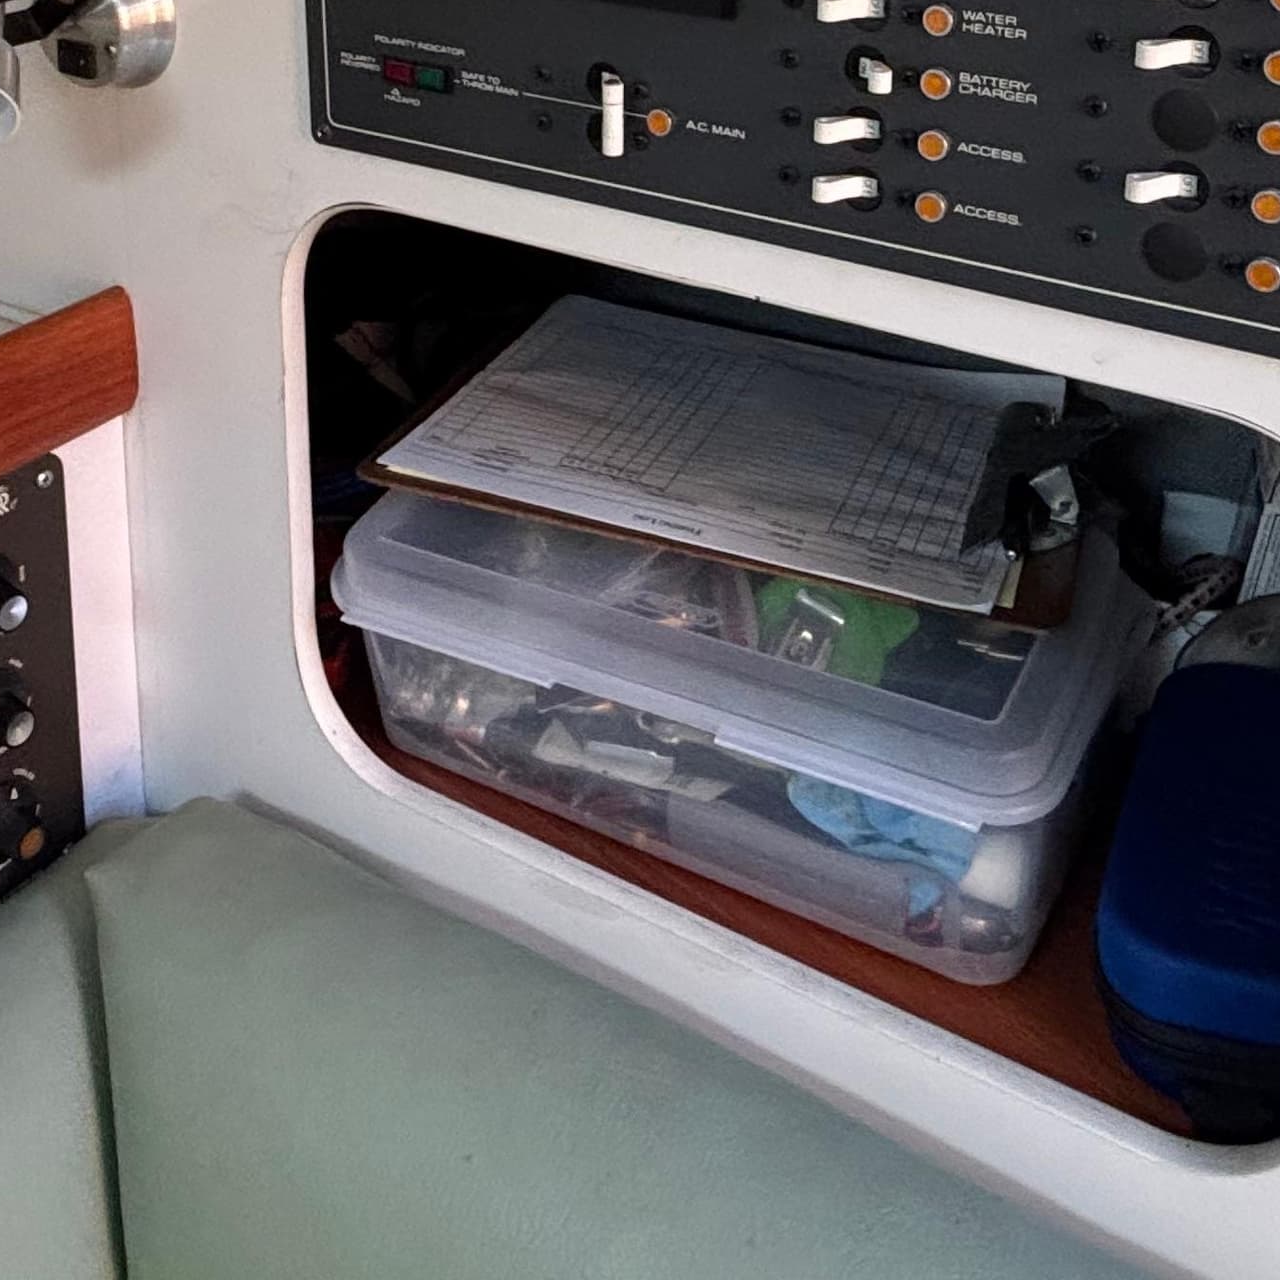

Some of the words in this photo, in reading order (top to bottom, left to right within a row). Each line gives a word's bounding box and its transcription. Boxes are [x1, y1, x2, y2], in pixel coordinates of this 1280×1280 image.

[963, 10, 1017, 26] WATER
[962, 23, 1027, 40] HEATER
[374, 35, 416, 48] POLARITY
[418, 41, 465, 56] INDICATOR
[487, 75, 501, 85] TO
[959, 72, 1031, 91] BATTERY
[959, 83, 1037, 104] CHARGER
[686, 120, 709, 132] A.C.
[712, 125, 745, 139] MAIN
[957, 142, 1027, 163] ACCESS.
[954, 203, 1022, 226] ACCESS.
